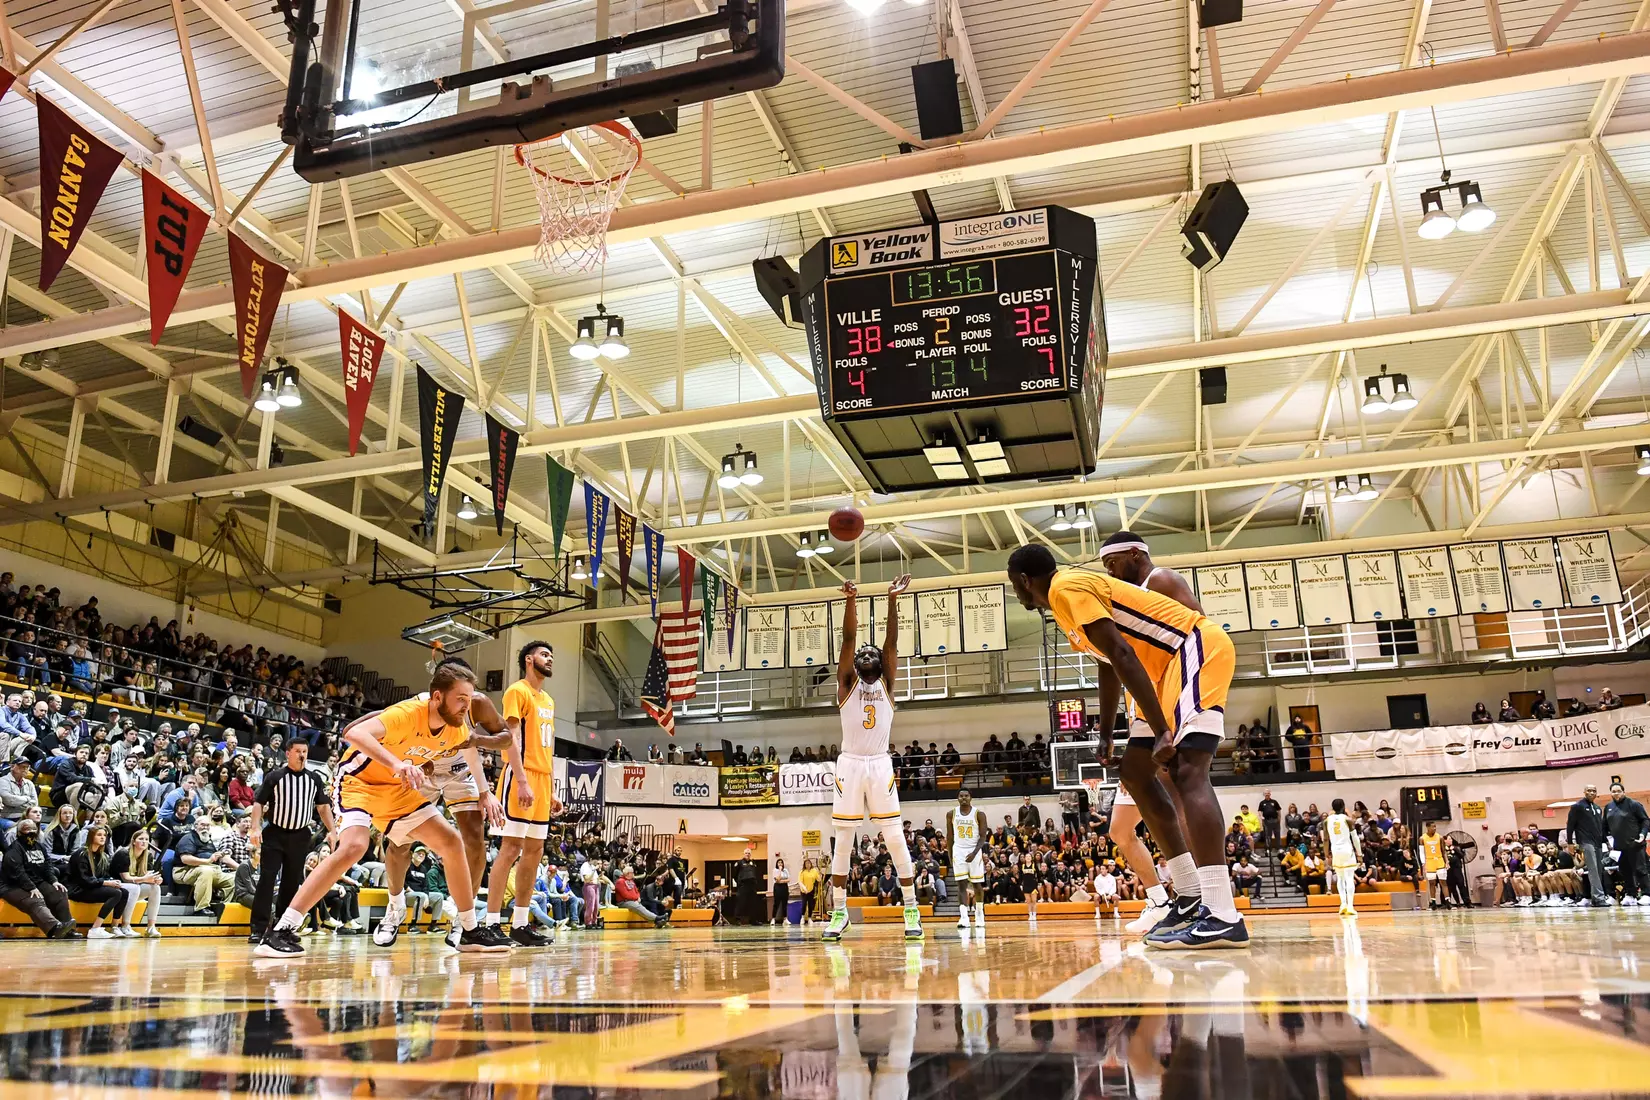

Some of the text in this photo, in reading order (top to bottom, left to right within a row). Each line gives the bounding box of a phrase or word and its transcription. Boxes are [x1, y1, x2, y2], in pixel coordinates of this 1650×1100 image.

[48, 133, 91, 249] GANNON
[154, 191, 190, 277] IUP
[862, 233, 930, 251] Yellow
[869, 247, 923, 265] Book
[908, 265, 983, 299] 13:56
[998, 287, 1054, 306] GUEST
[241, 260, 265, 367] KUTZTOWN
[837, 309, 882, 326] VILLE
[922, 305, 961, 318] PERIOD
[966, 313, 991, 325] POSS
[1013, 304, 1050, 336] 32
[894, 322, 919, 333] POSS
[935, 317, 950, 345] 2
[1070, 258, 1082, 389] MILLERSVILLE
[847, 325, 882, 356] 38
[895, 336, 926, 349] BONUS
[961, 329, 992, 341] BONUS
[1021, 334, 1058, 347] FOULS
[808, 292, 830, 416] MILLERSVILLE
[915, 346, 957, 359] PLAYER
[963, 342, 992, 354] FOUL
[345, 326, 362, 391] HAVEN
[359, 336, 375, 383] LOCK
[835, 357, 868, 369] FOULS
[1037, 347, 1055, 375] 7
[931, 359, 956, 387] 13
[970, 356, 988, 381] 4
[848, 370, 865, 395] 4
[1020, 377, 1060, 390] SCORE
[931, 387, 969, 400] MATCH
[836, 398, 873, 410] SCORE
[429, 388, 446, 497] MILLERSVILLE
[496, 429, 508, 511] MANSFIELD
[590, 491, 598, 558] JOHNSTOWN
[1412, 547, 1446, 555] TOURNAMENT
[1570, 558, 1605, 566] WRESTLING
[1058, 701, 1083, 713] 13:56
[862, 704, 876, 729] 3
[1059, 711, 1081, 729] 30
[1550, 720, 1599, 738] UPMC
[1473, 739, 1501, 750] Frey
[1514, 736, 1542, 746] Lutz
[1552, 734, 1609, 752] Pinnacle
[782, 772, 834, 789] UPMC
[673, 786, 709, 797] CALECO
[679, 818, 687, 834] A
